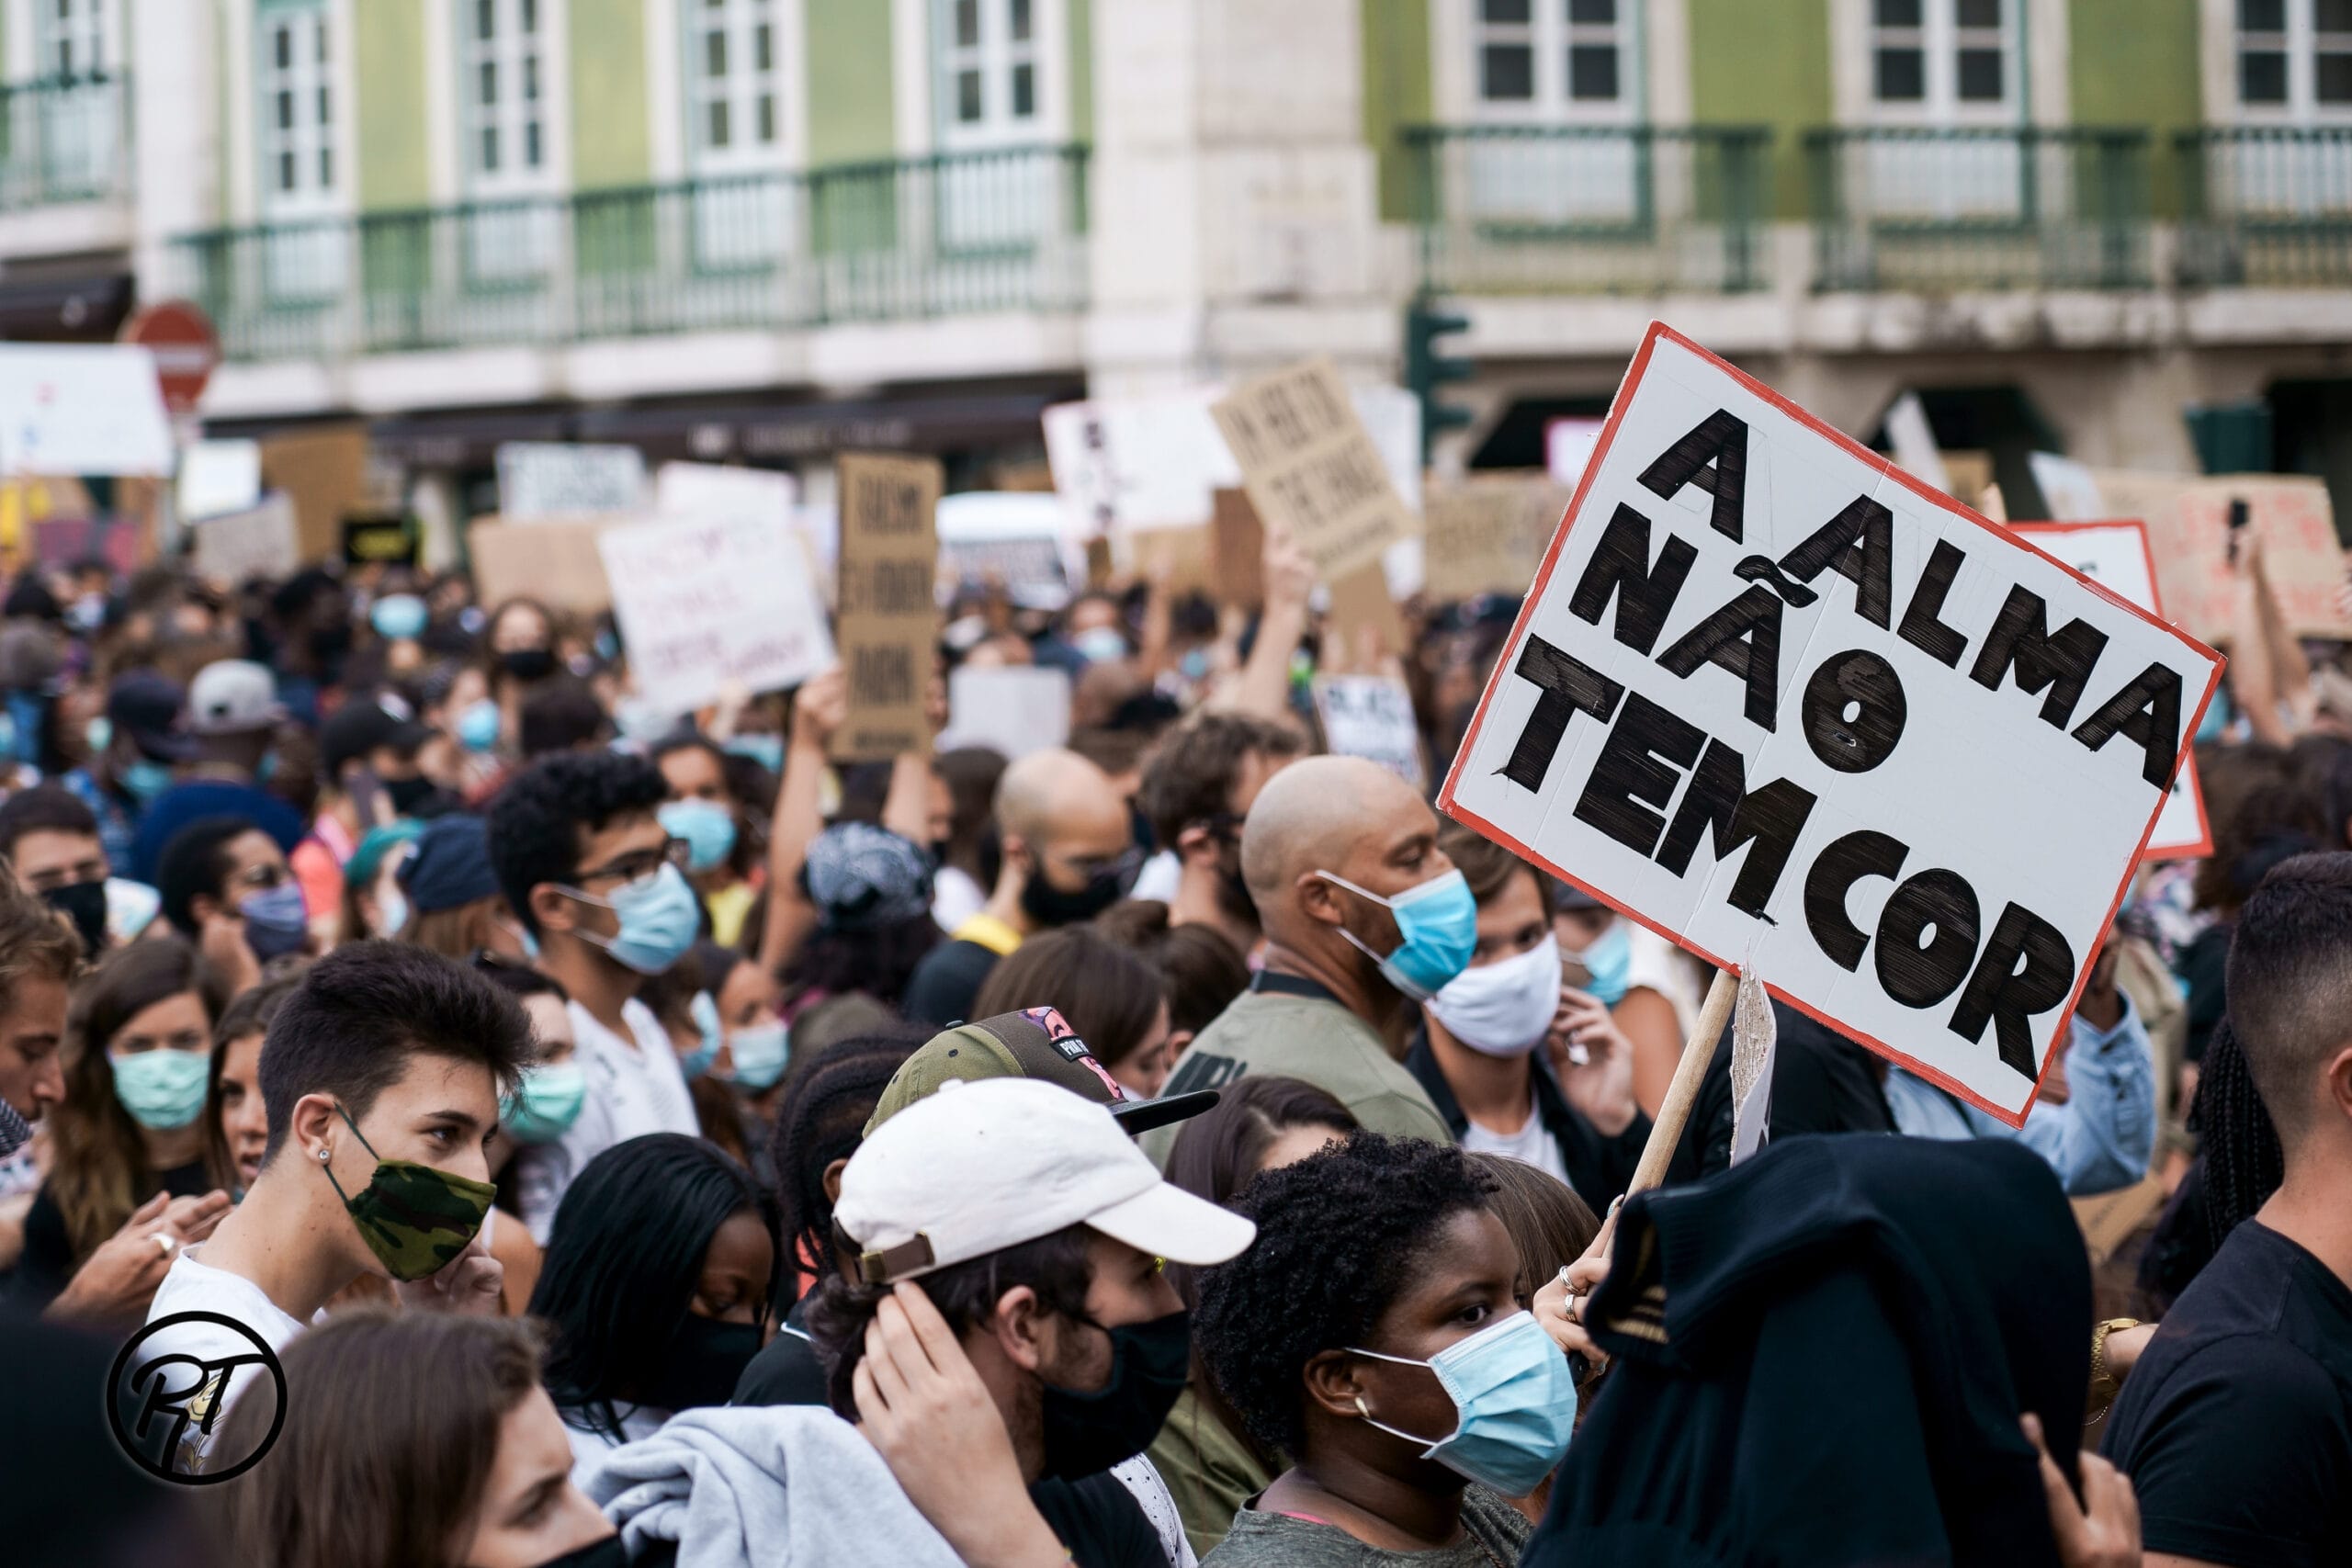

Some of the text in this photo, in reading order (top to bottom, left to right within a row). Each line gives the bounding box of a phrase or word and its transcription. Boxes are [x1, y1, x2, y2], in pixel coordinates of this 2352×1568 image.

[1567, 502, 1908, 774] NÃO
[1636, 408, 1748, 546] A
[1778, 493, 2183, 795] ALMA
[1491, 632, 2076, 1086] TEM COR
